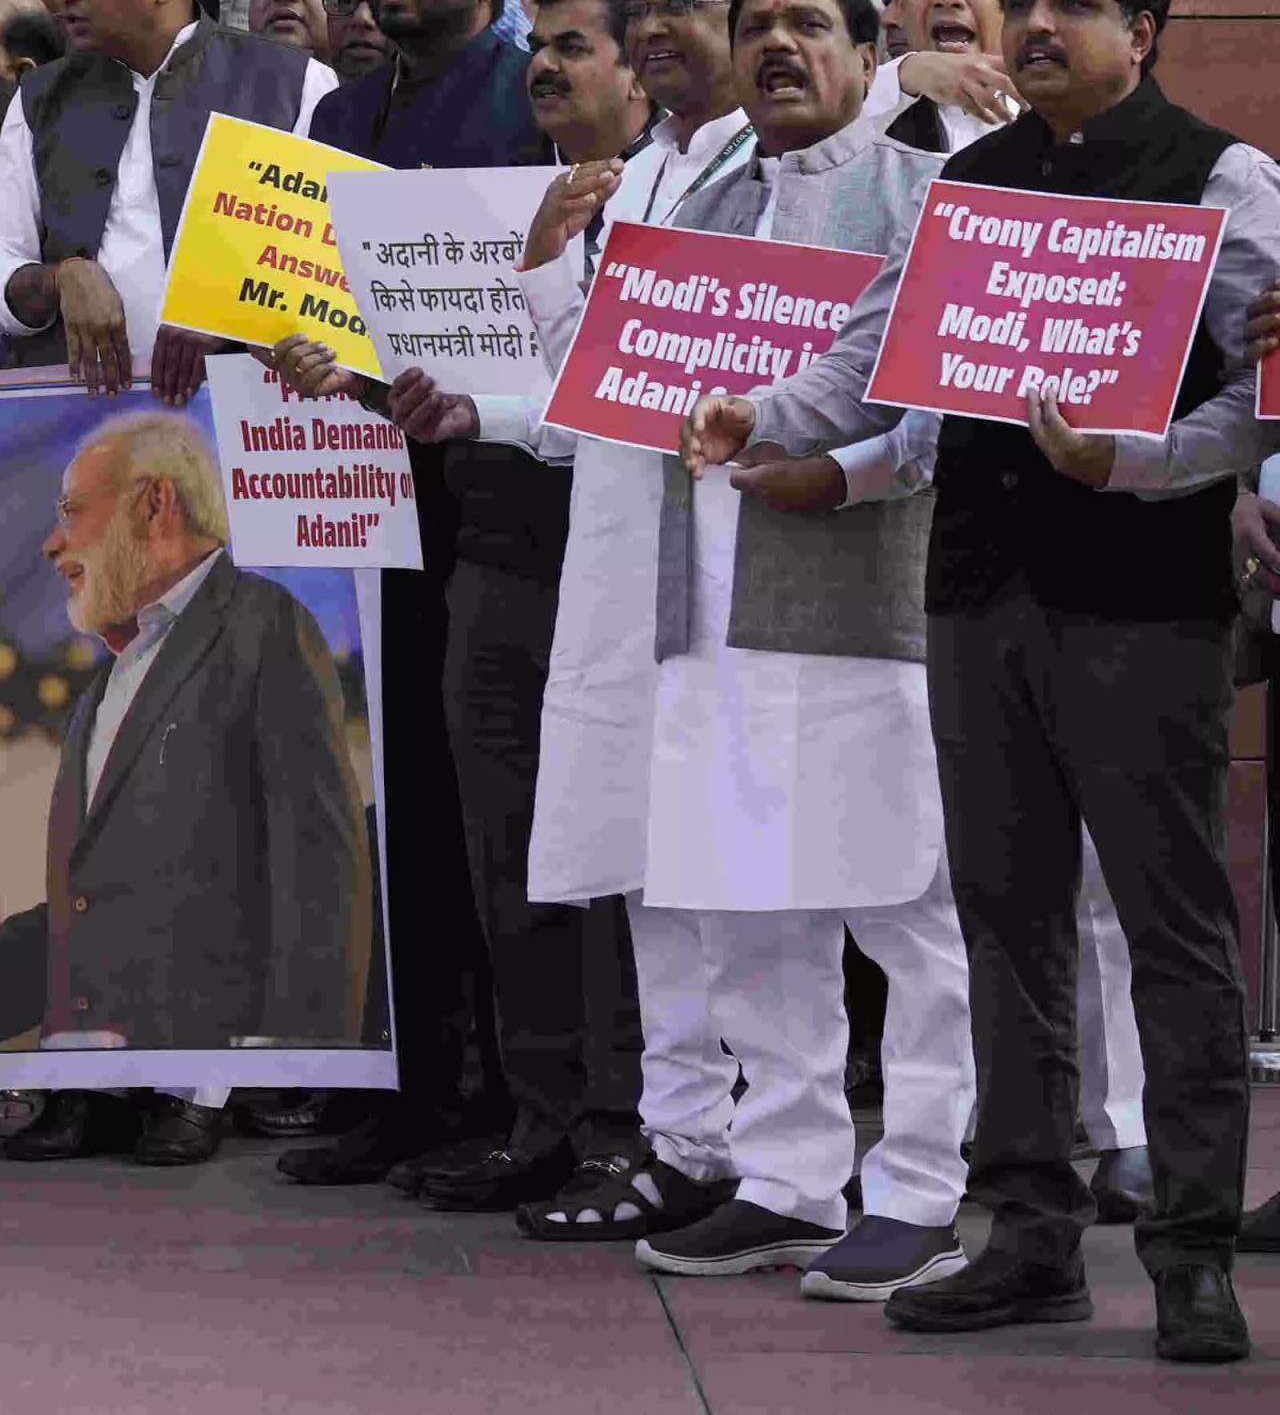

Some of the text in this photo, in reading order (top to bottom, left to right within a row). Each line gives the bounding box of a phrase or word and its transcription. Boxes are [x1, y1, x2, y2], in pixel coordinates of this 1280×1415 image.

[212, 191, 313, 238] Nation
[933, 201, 1207, 263] “Crony Capitalism
[256, 244, 351, 293] Answe
[376, 234, 439, 269] अदानी
[443, 232, 465, 265] के
[238, 277, 289, 312] Mr.
[370, 278, 526, 314] किसे फायदा होत
[604, 261, 854, 332] “Modi’s Silence
[985, 260, 1127, 308] Exposed:
[387, 325, 475, 358] प्रधानमंत्री
[476, 324, 523, 358] मोदी
[618, 318, 792, 385] Complicity
[937, 303, 1142, 357] Modi, What’s
[595, 366, 702, 416] Adani
[939, 352, 1119, 406] Your Role?”
[240, 416, 306, 453] India
[232, 464, 396, 507] Accountability
[297, 513, 379, 548] Adani!”
